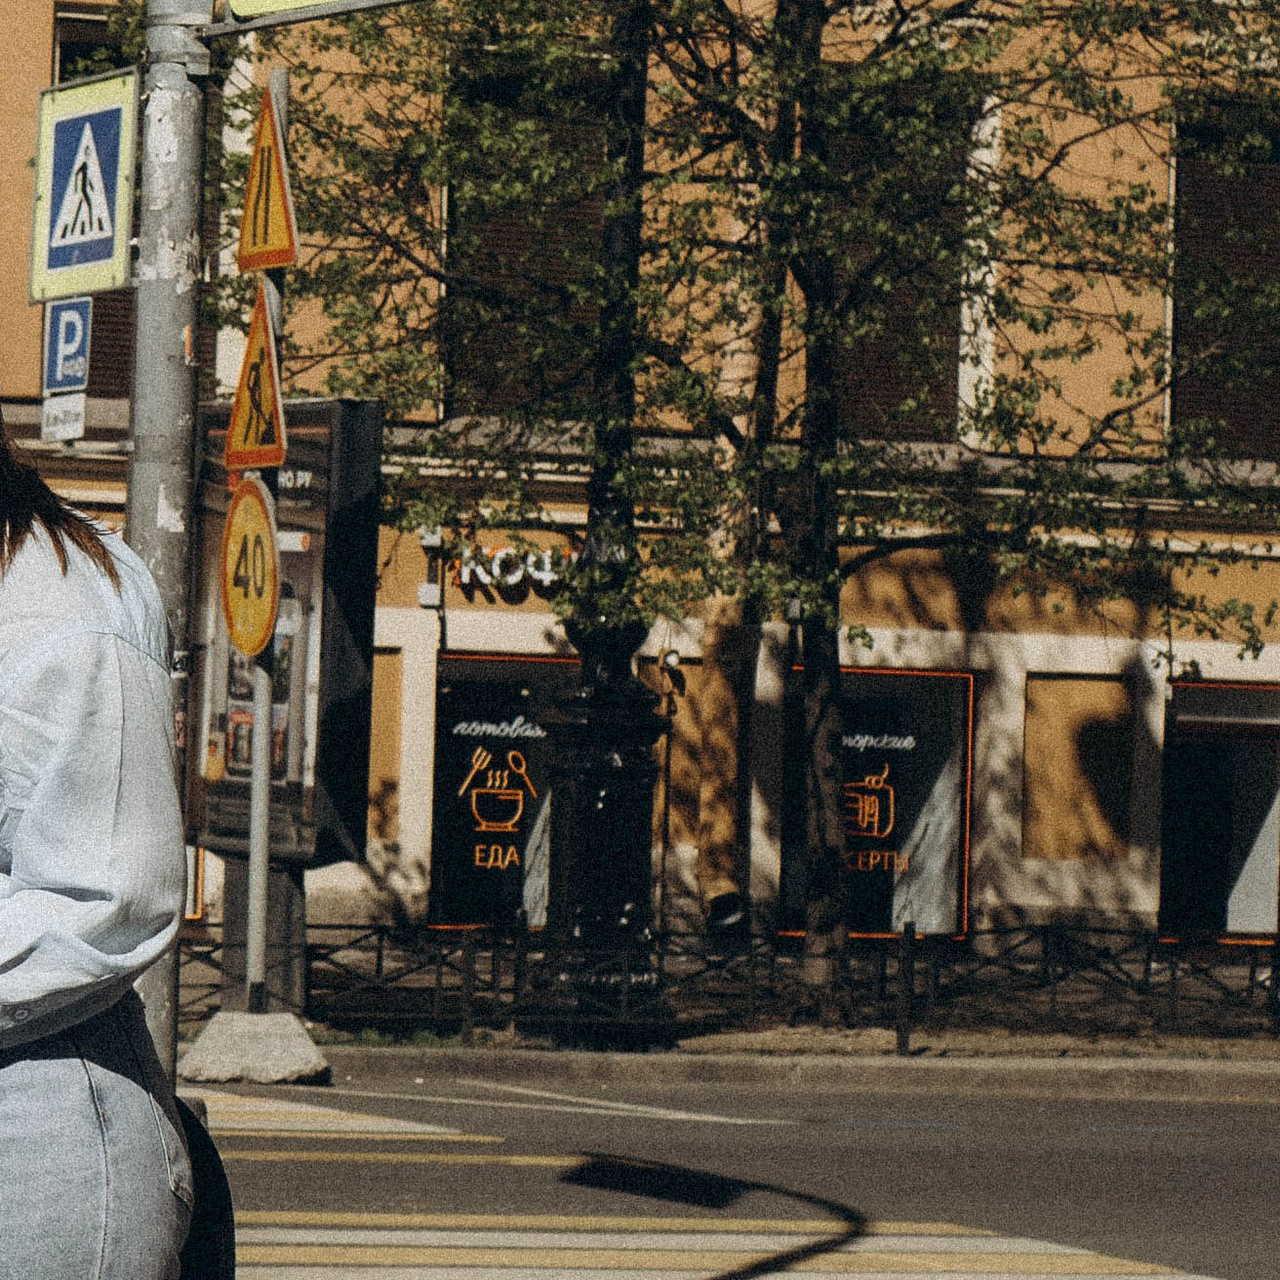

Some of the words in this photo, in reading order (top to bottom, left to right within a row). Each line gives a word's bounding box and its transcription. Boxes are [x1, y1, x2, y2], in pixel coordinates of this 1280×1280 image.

[56, 308, 84, 381] P
[231, 533, 266, 600] 40
[456, 545, 578, 587] КОФ
[452, 715, 548, 739] готовая
[474, 844, 521, 870] ЕДА
[842, 849, 911, 874] СЕРТЫ
